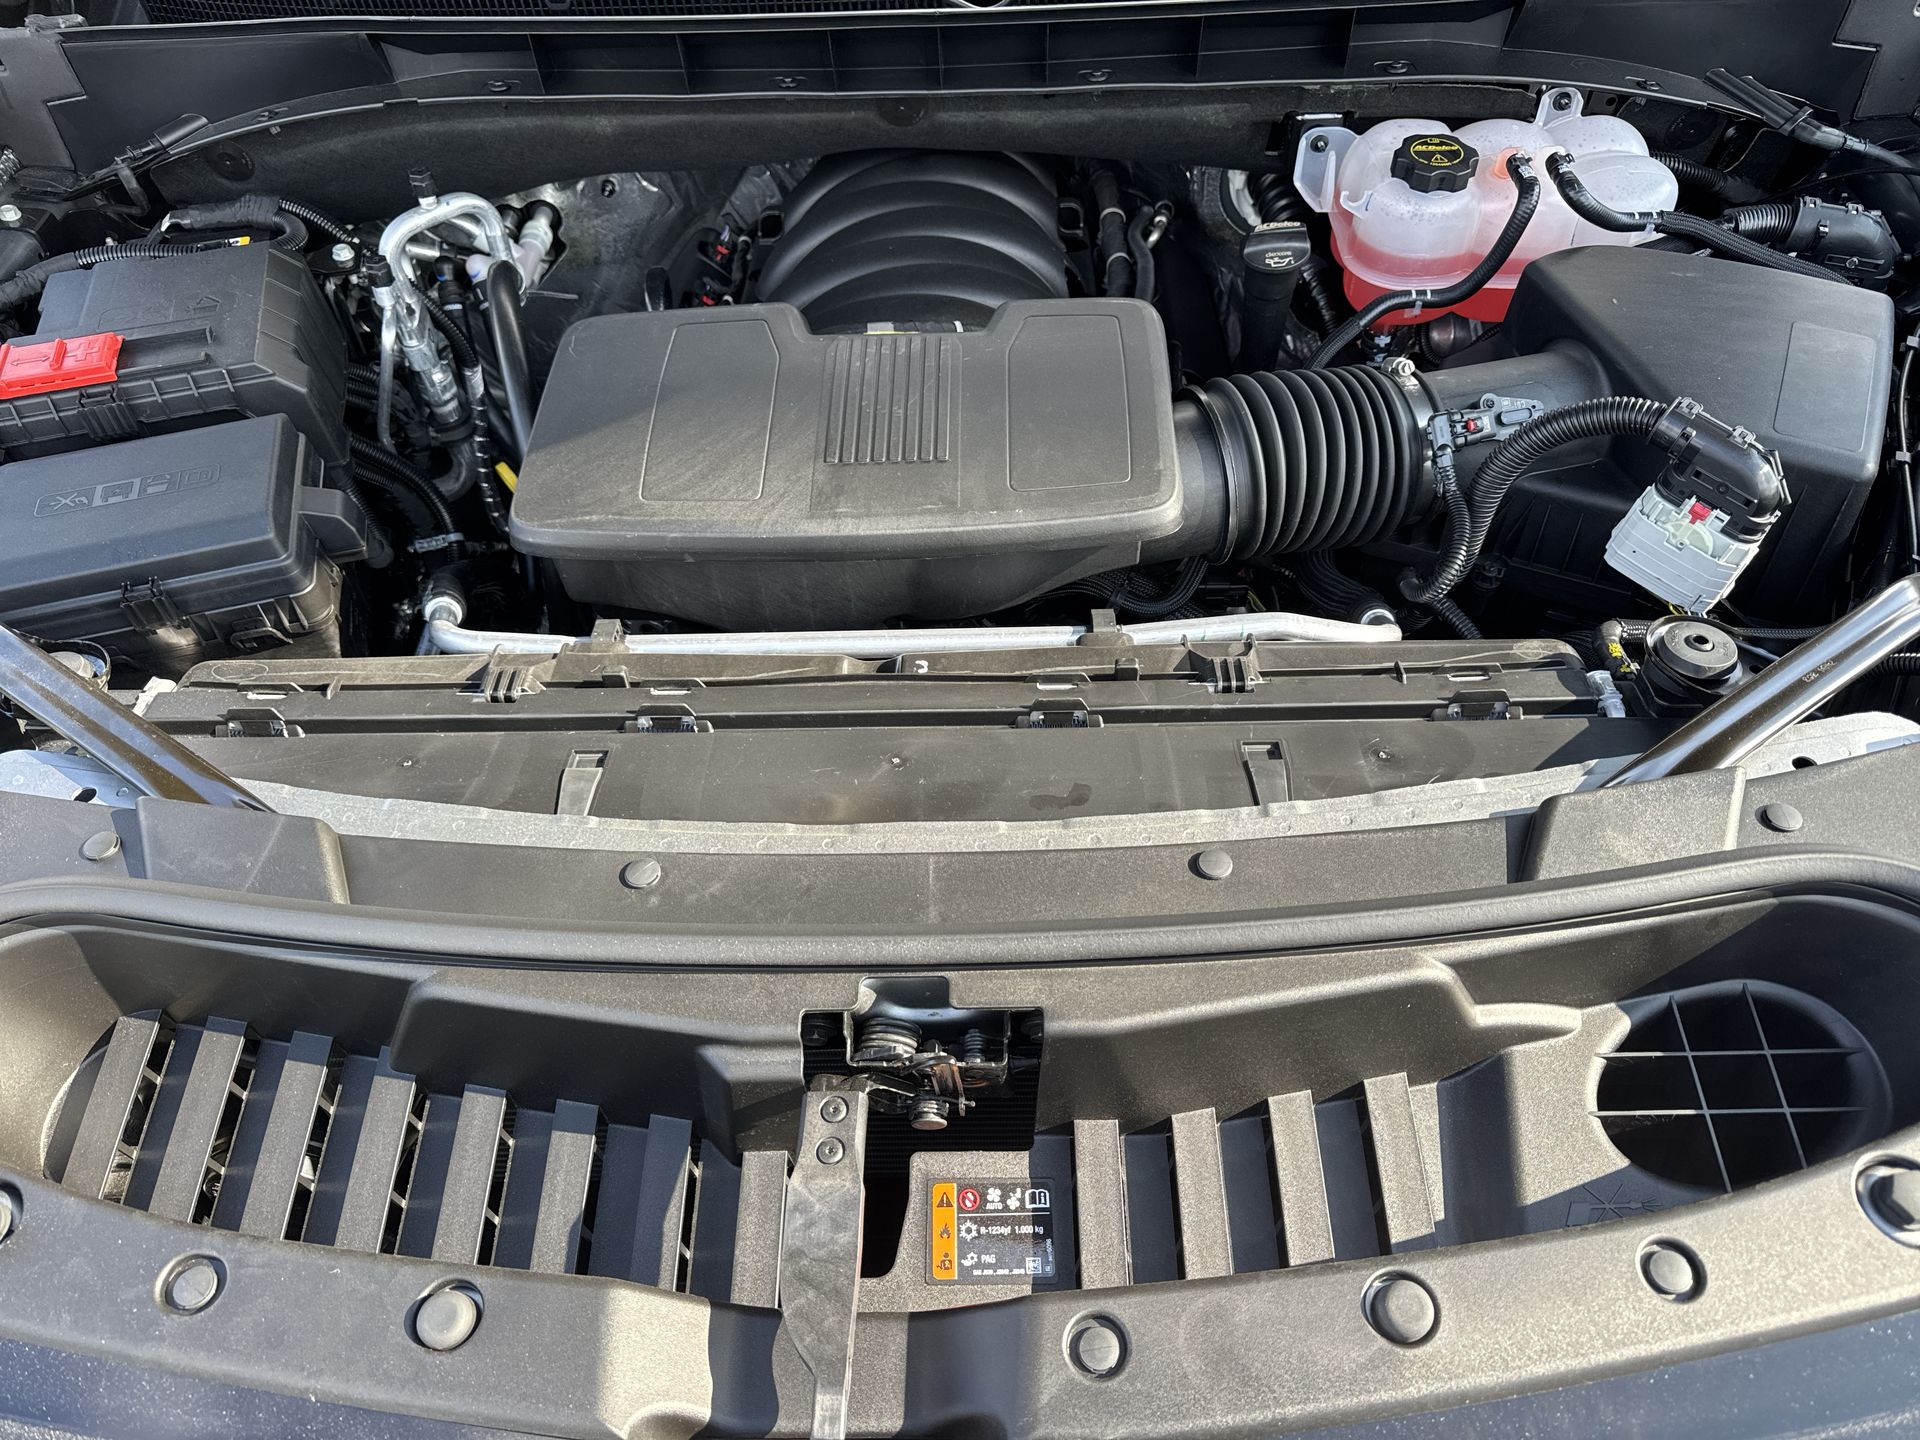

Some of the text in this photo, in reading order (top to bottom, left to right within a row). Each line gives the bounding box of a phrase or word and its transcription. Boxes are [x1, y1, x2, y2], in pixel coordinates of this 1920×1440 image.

[1254, 221, 1301, 232] ACDelco
[986, 1202, 1003, 1210] AUTO
[1014, 1225, 1033, 1234] 1.000
[1034, 1225, 1044, 1235] kg
[981, 1254, 996, 1264] PAG
